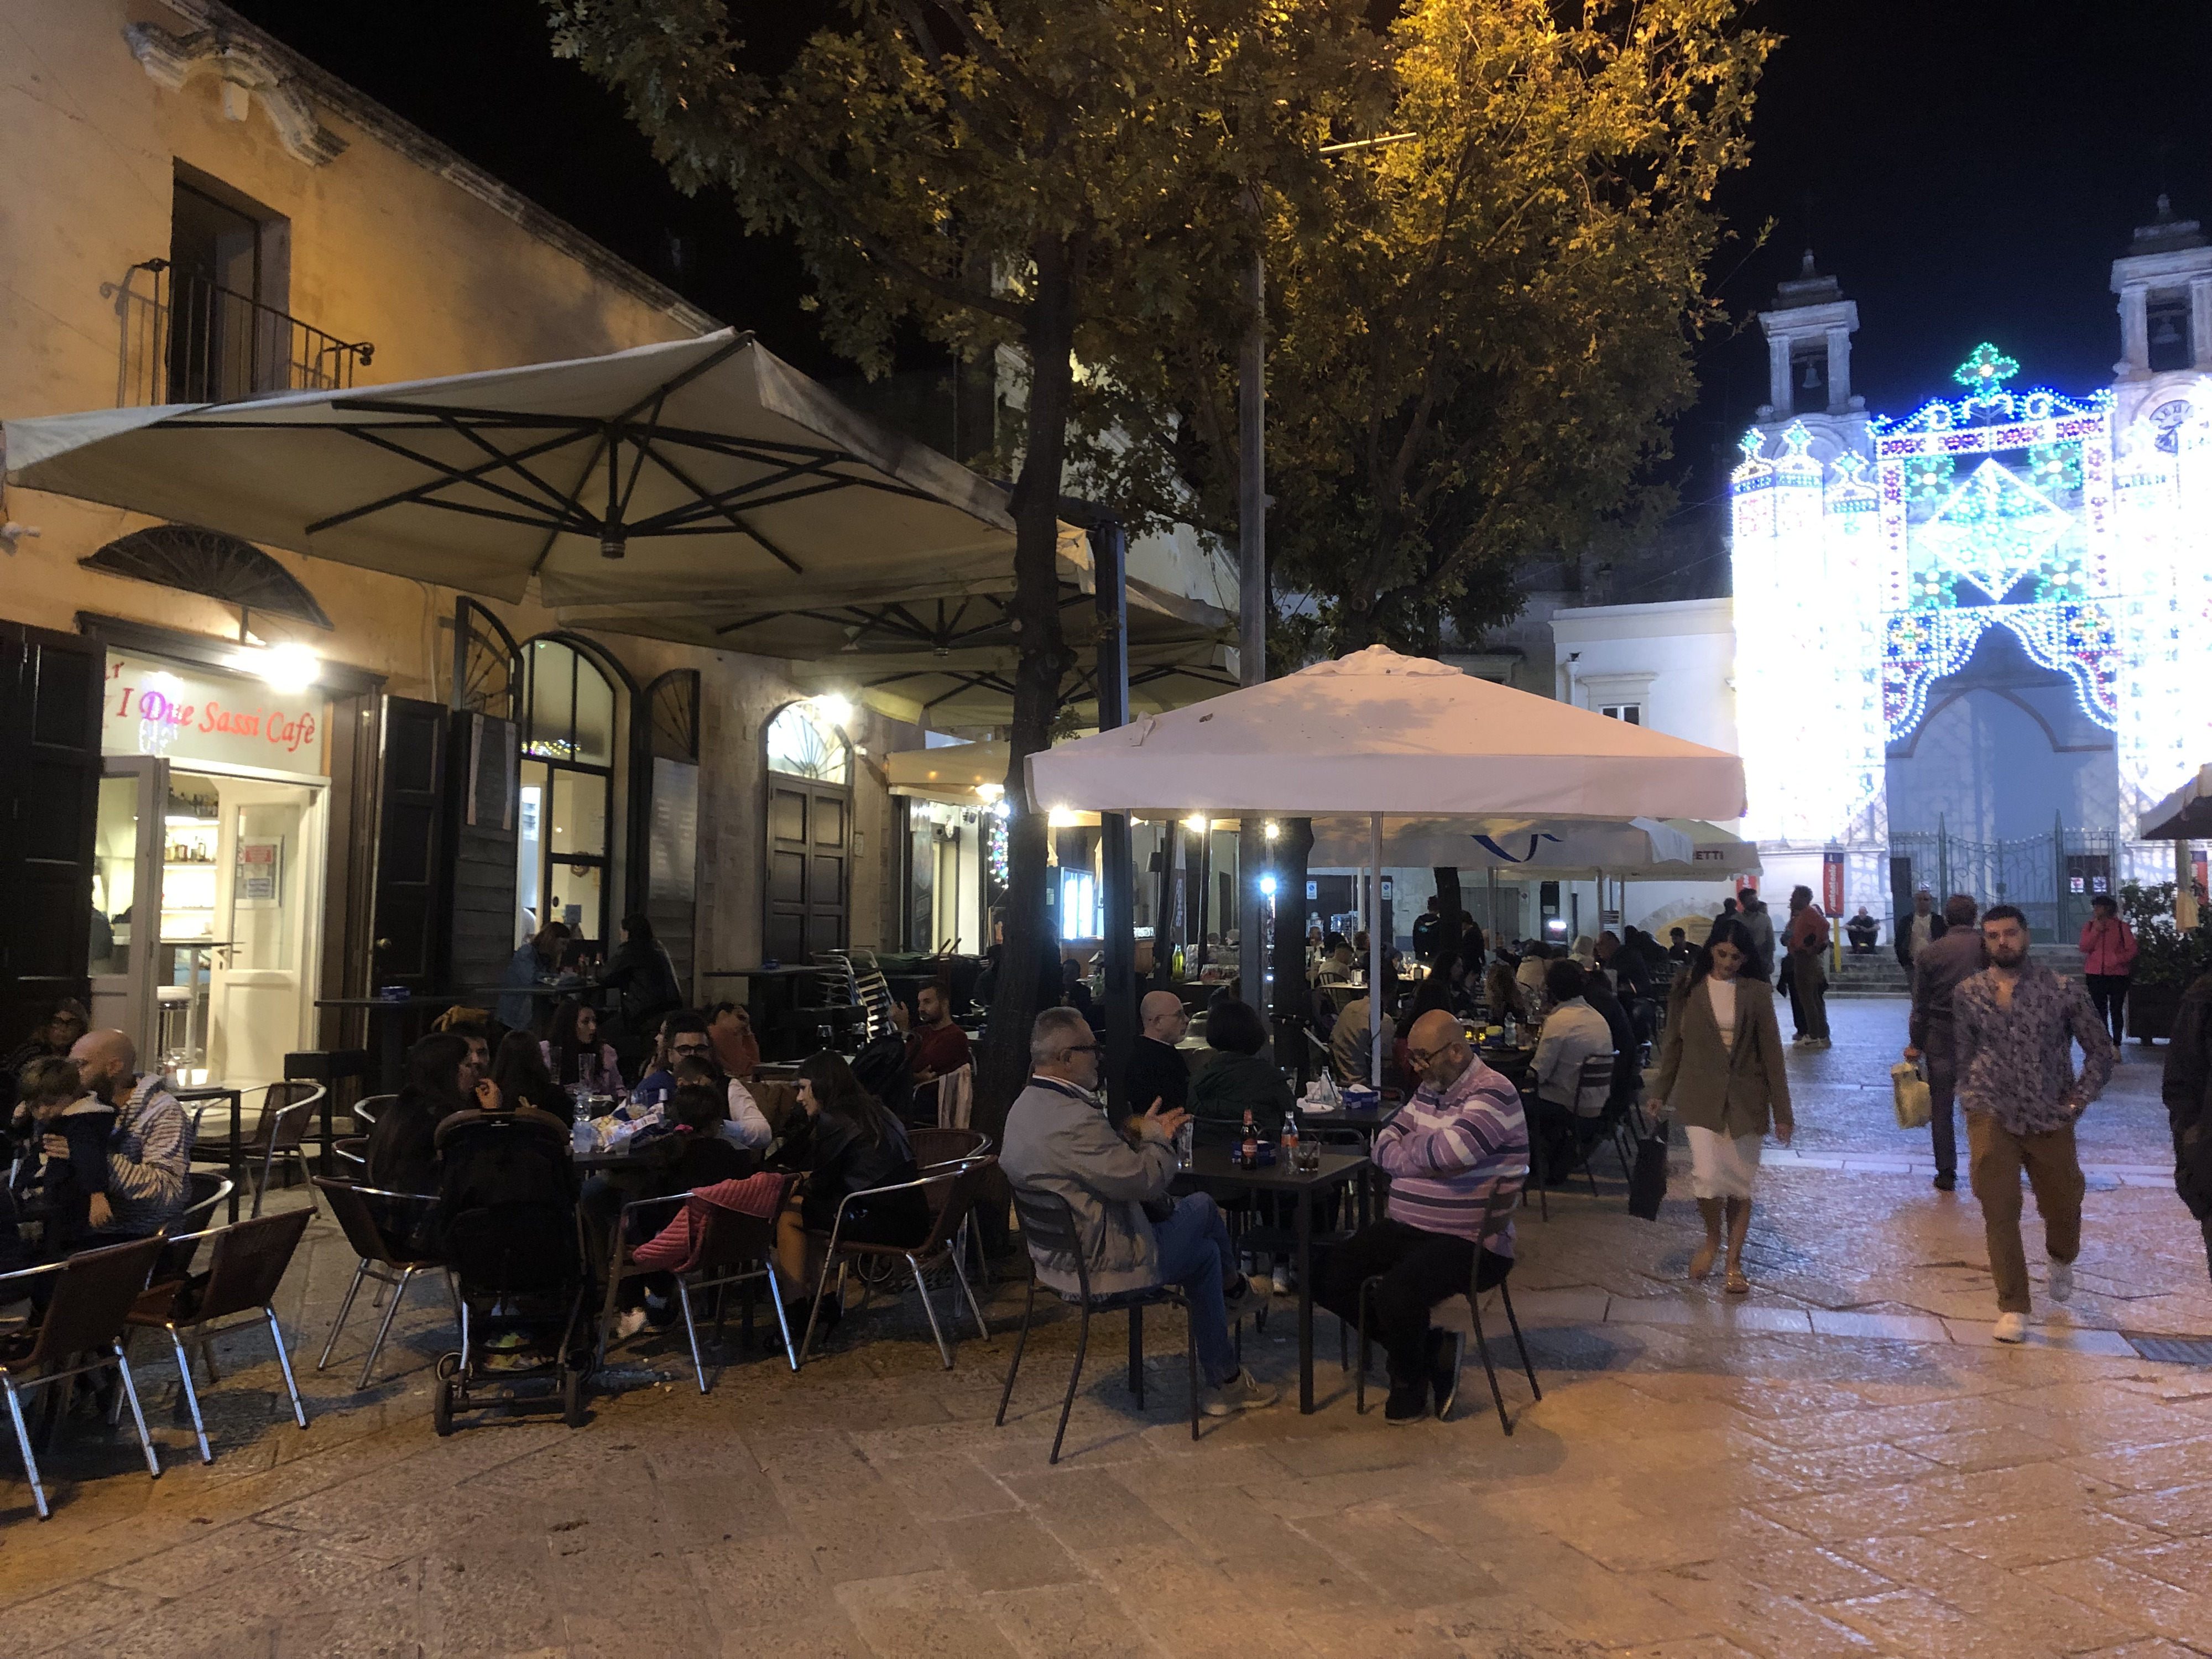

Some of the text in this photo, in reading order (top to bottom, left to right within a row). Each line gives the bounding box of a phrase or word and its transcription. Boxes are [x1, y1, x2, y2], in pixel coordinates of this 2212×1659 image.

[116, 687, 315, 752] I Due Sassi Cafè
[1693, 851, 1724, 860] ETTI
